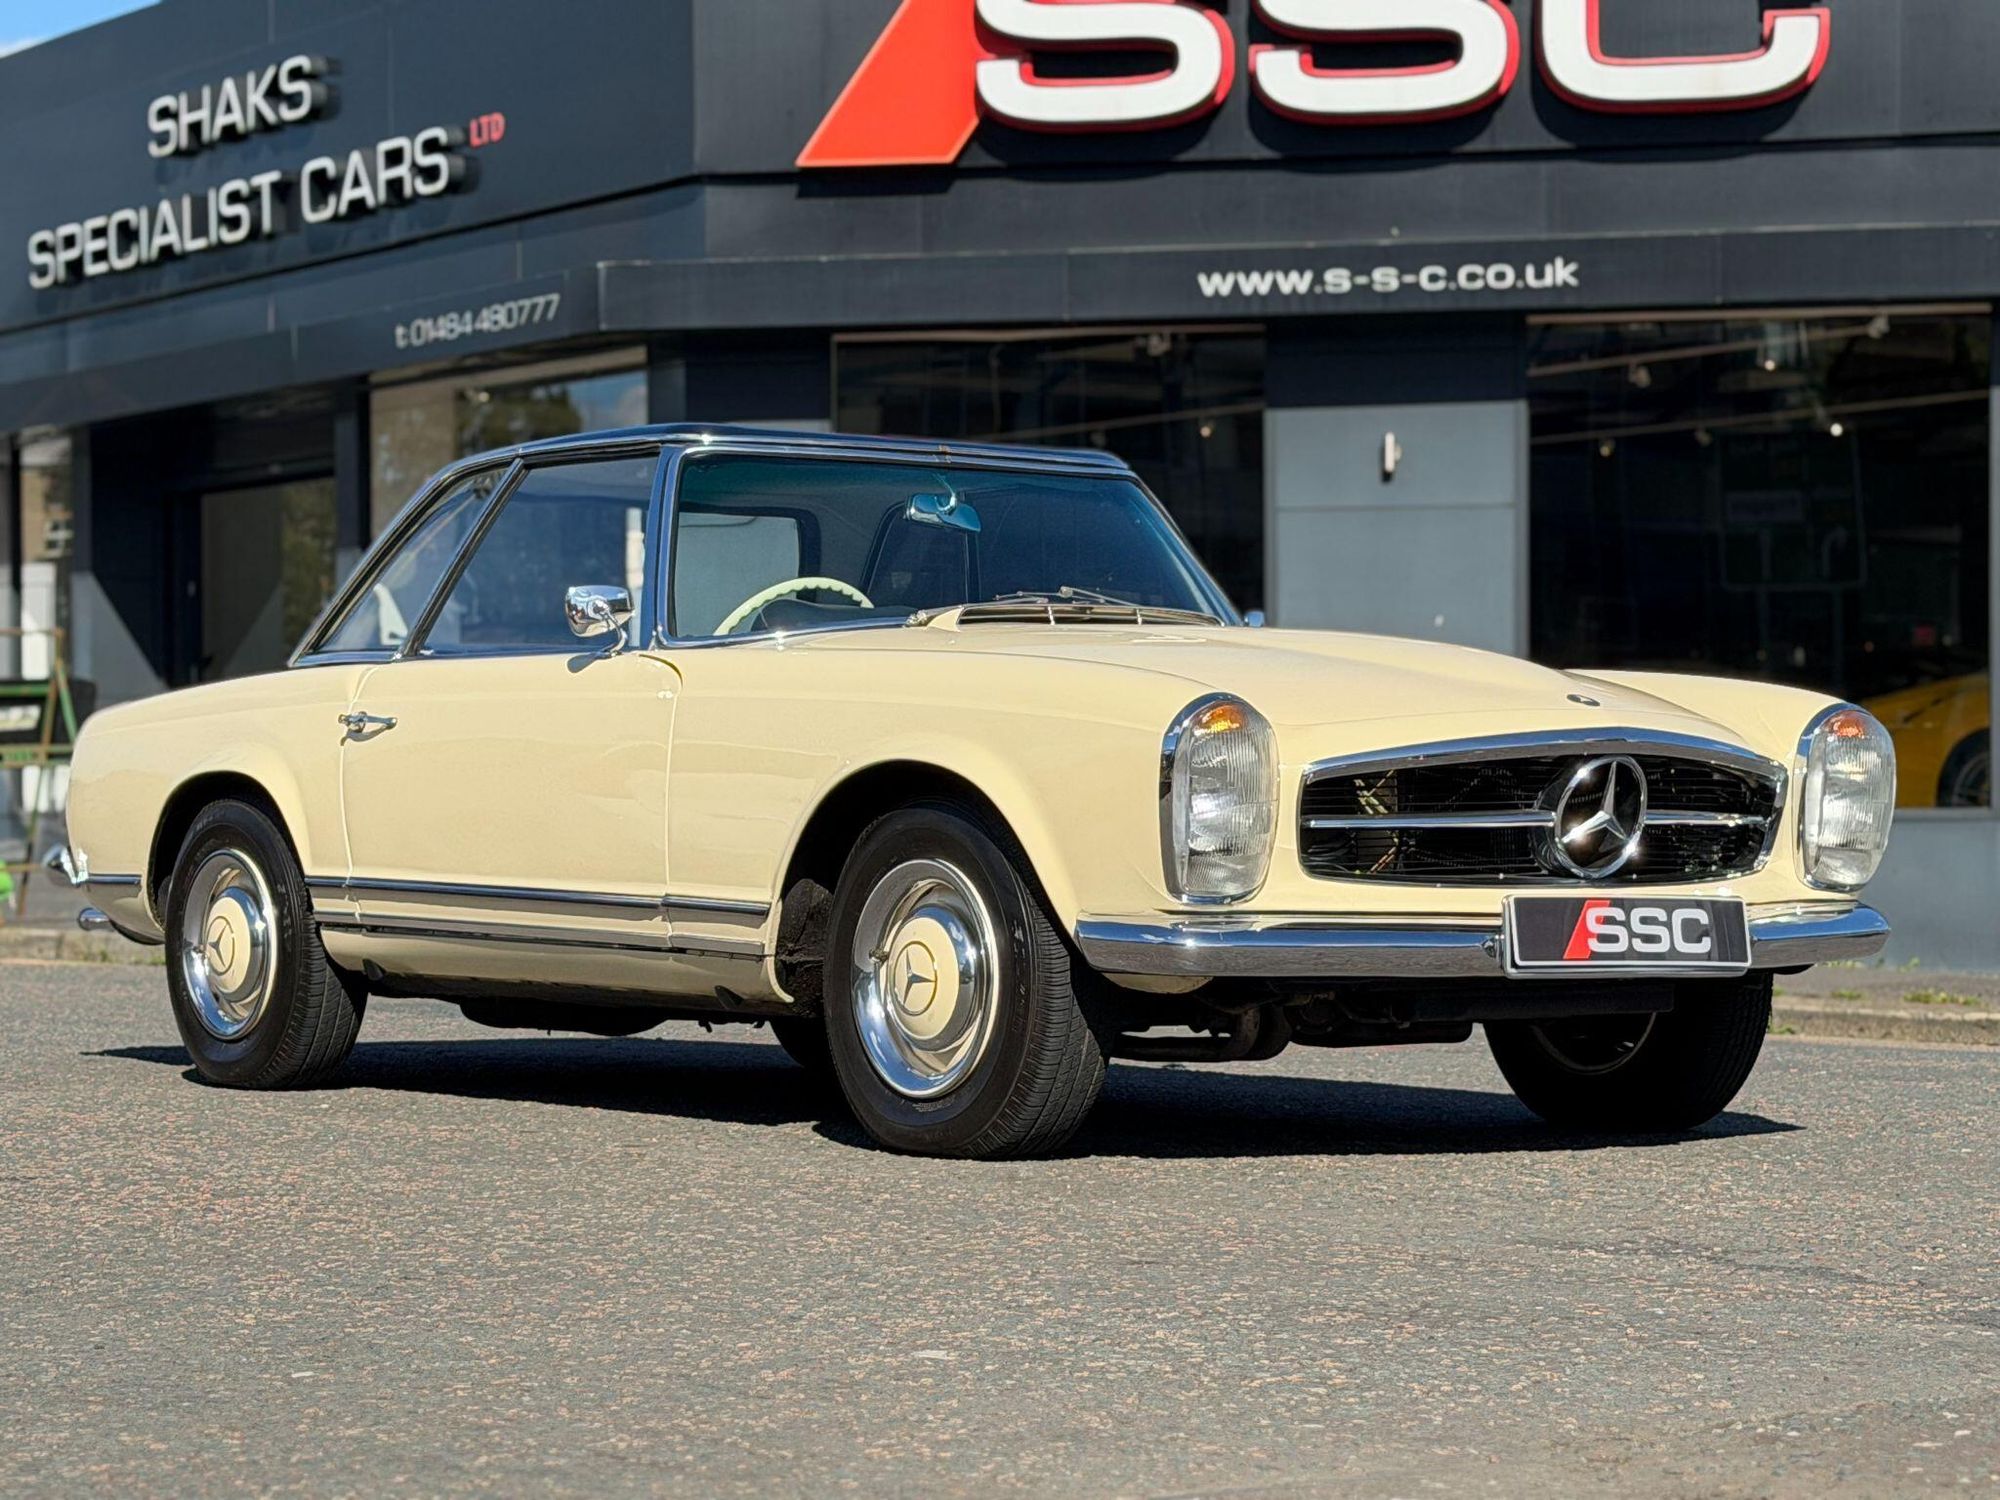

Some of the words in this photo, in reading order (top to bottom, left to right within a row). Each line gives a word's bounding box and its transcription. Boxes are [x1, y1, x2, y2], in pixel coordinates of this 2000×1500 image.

[148, 55, 313, 158] SHAKS
[28, 171, 281, 288] SPECIALIST
[301, 127, 449, 222] CARS
[469, 112, 505, 147] LTD
[1198, 256, 1579, 297] www.s-s-c.co.uk
[1586, 907, 1711, 953] SSC
